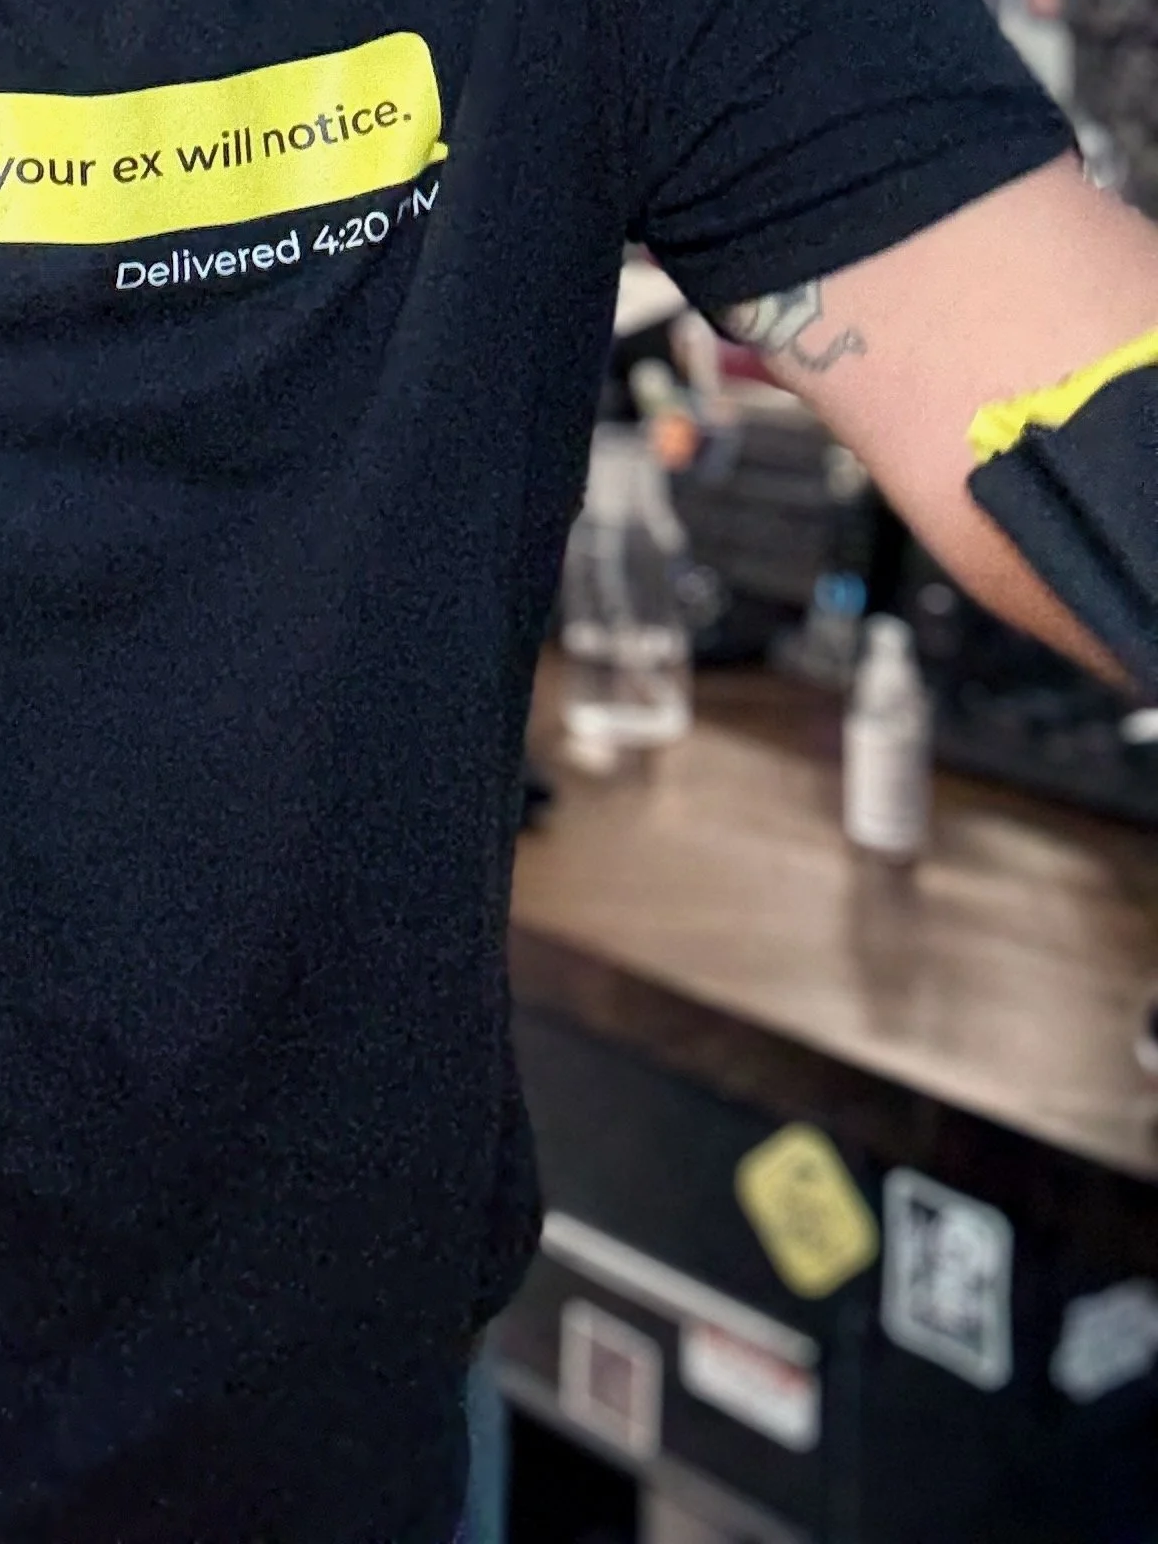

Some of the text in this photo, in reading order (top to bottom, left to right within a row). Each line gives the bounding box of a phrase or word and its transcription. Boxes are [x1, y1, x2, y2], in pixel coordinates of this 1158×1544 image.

[112, 150, 164, 184] ex
[175, 126, 253, 173] will
[262, 101, 412, 158] notice.
[114, 229, 301, 290] Delivered
[312, 211, 390, 256] 4:20
